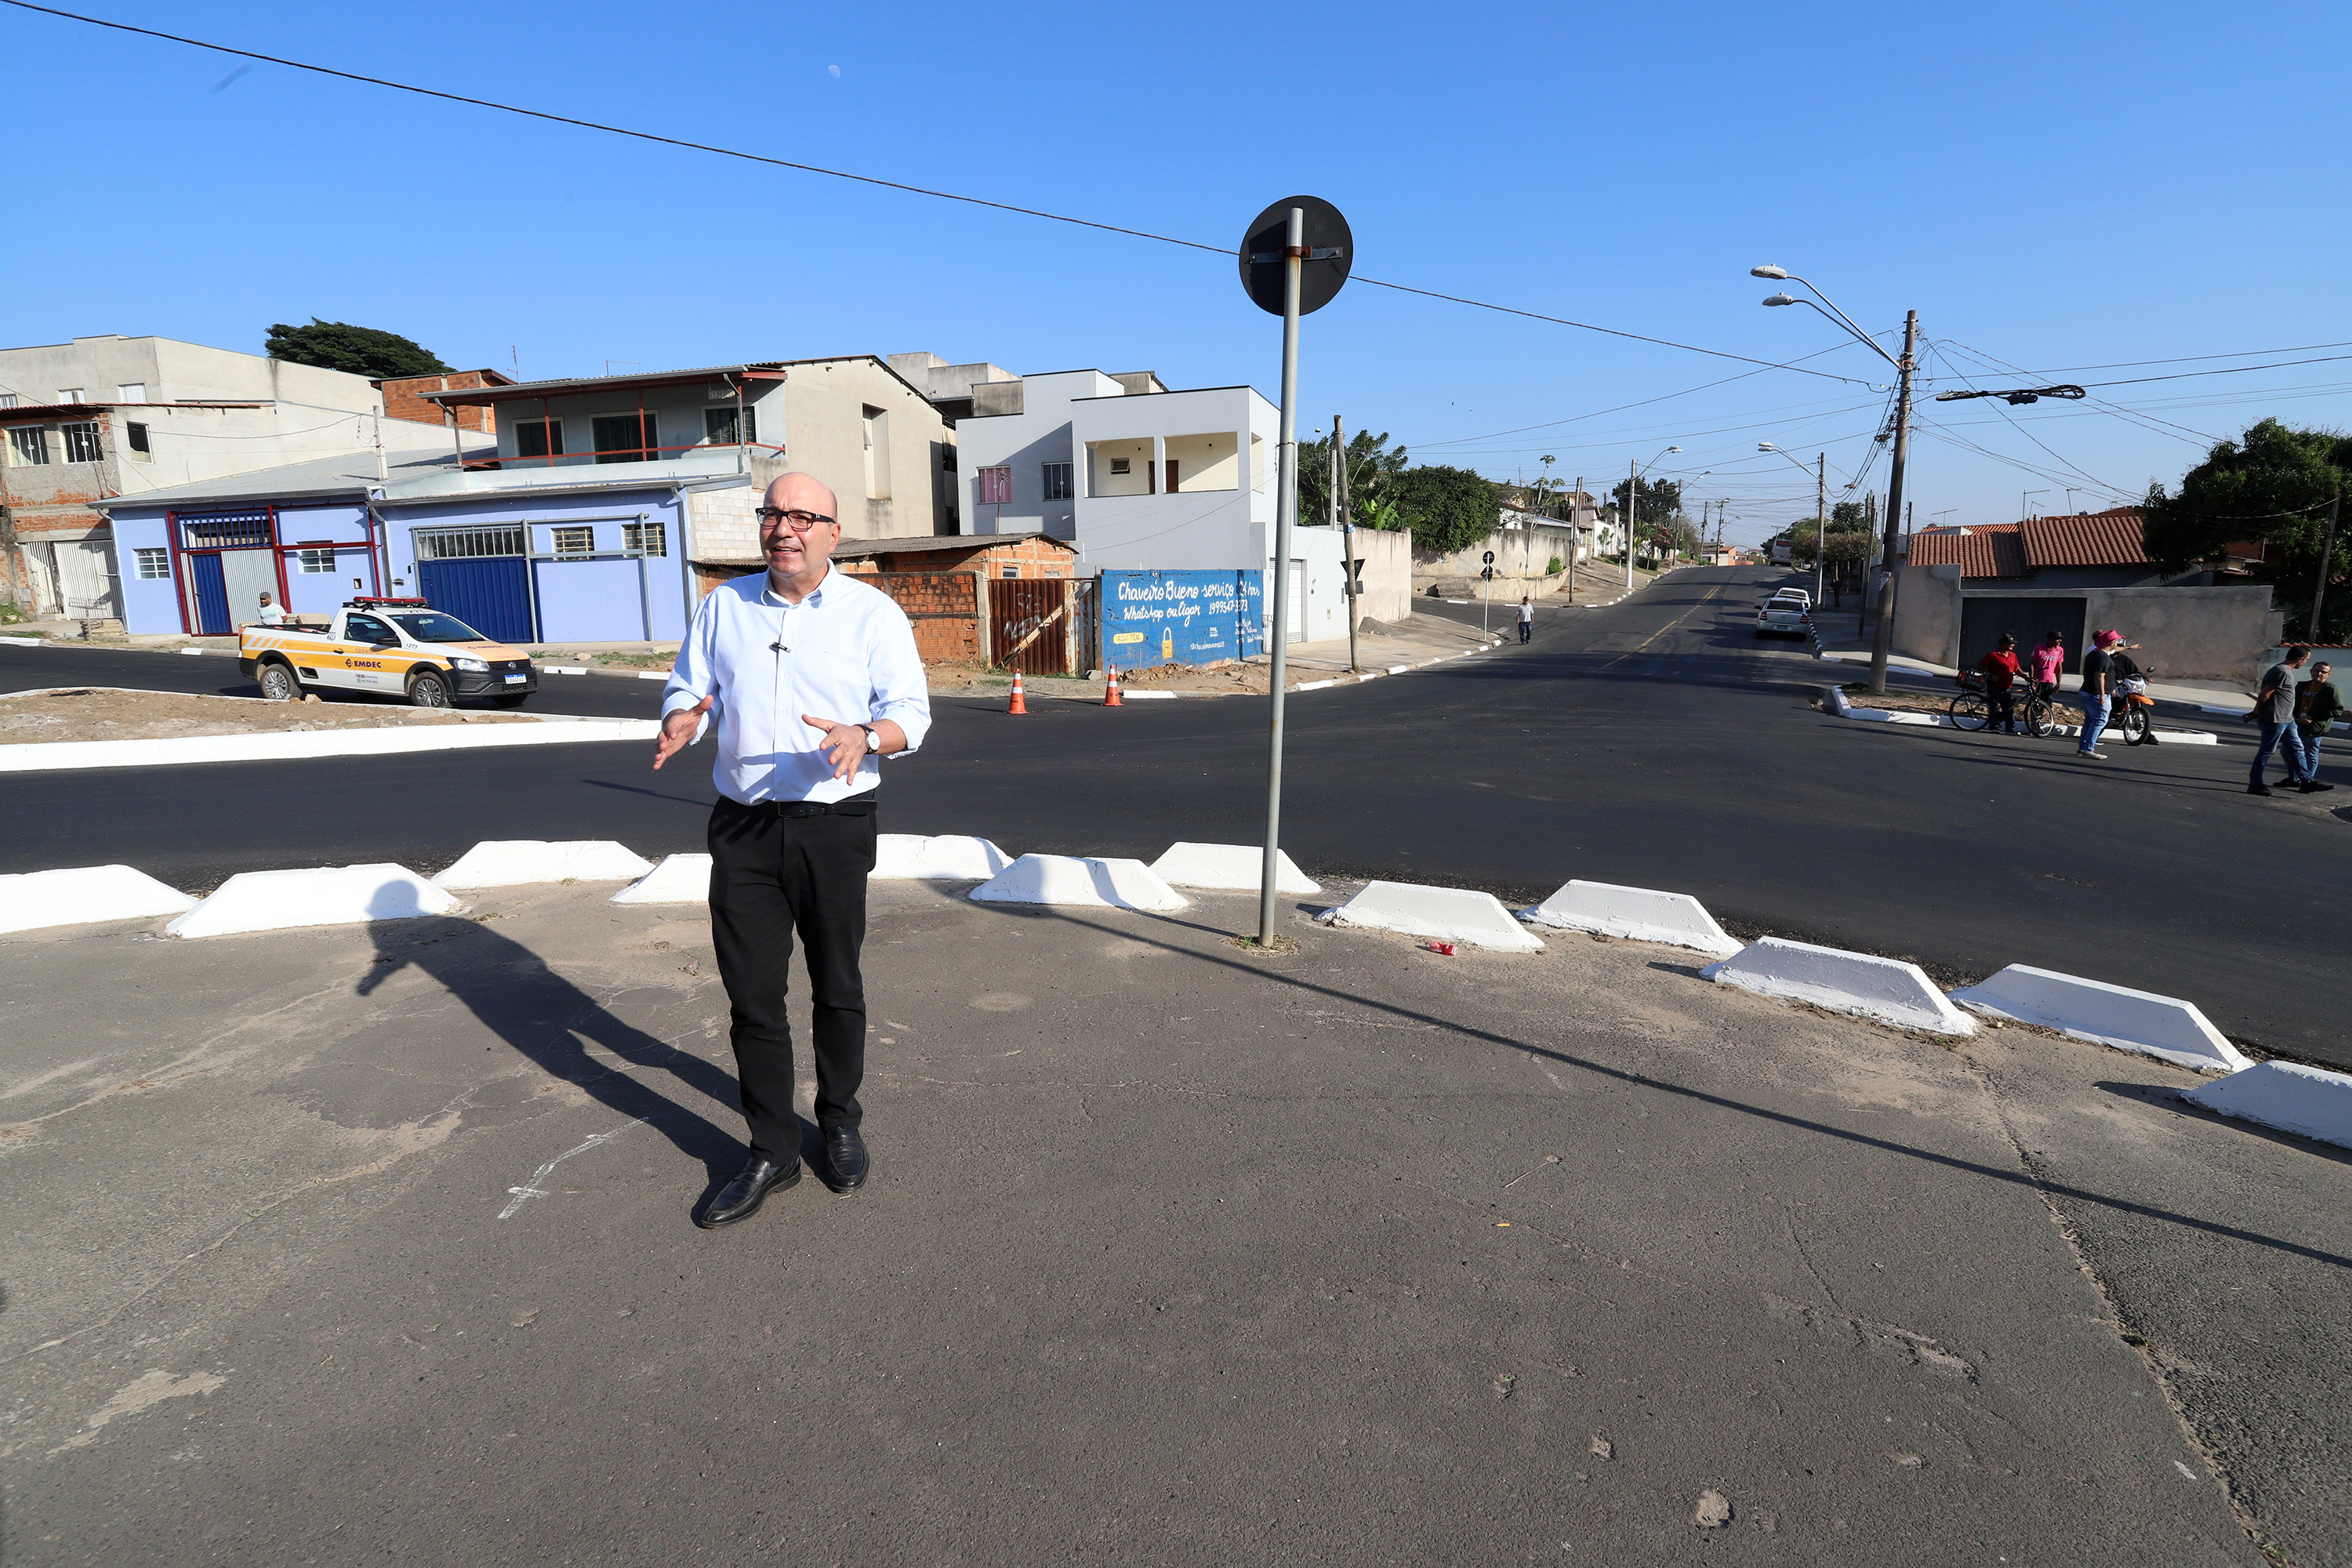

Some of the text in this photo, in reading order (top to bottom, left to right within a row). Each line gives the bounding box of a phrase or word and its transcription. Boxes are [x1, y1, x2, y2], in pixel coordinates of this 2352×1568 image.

[1118, 582, 1164, 601] Chaveiro
[1165, 580, 1199, 601] Bueno
[1201, 582, 1234, 601] serviço
[1123, 605, 1163, 622] WhatsApp
